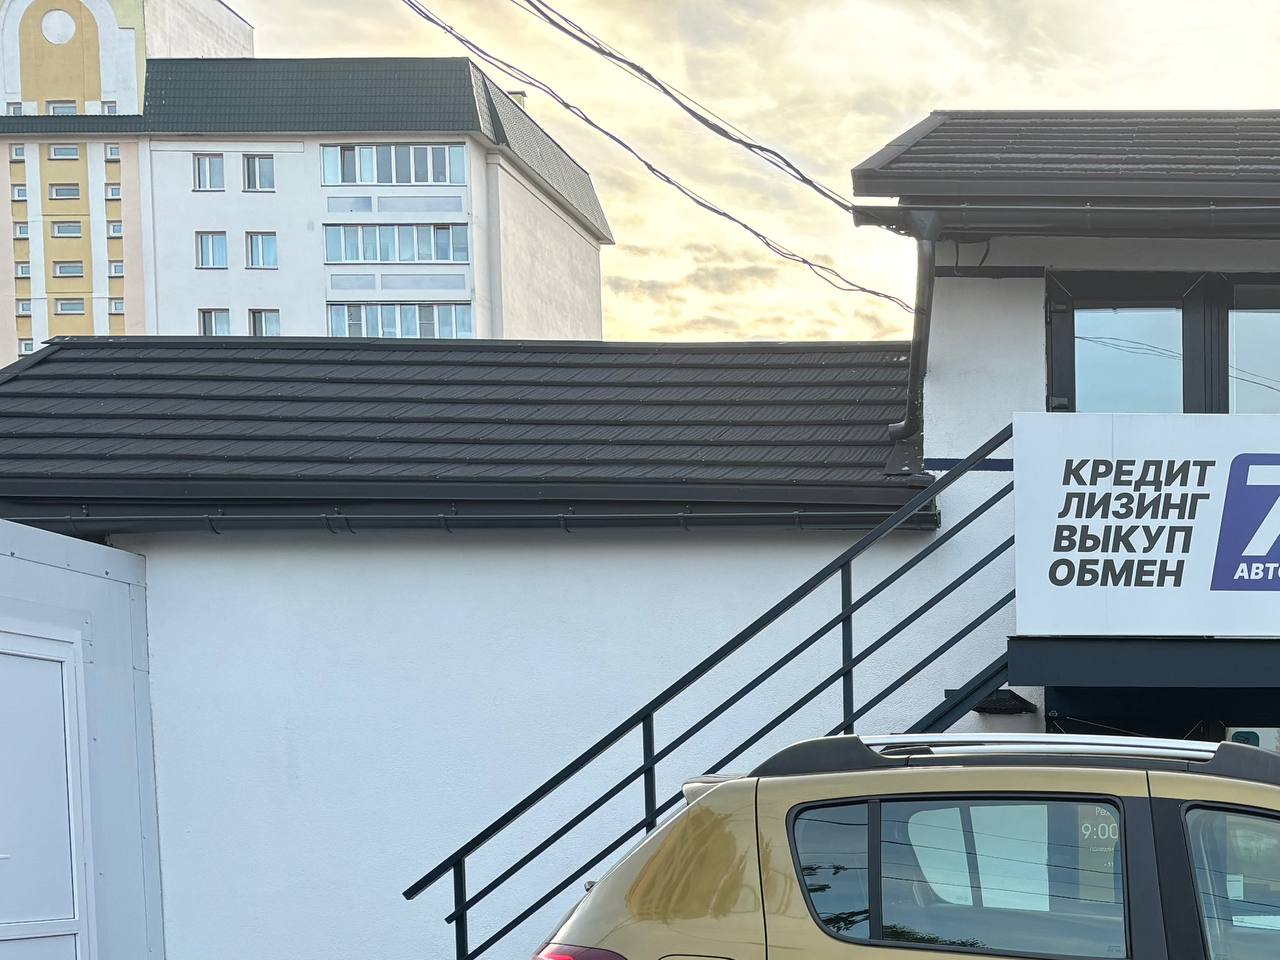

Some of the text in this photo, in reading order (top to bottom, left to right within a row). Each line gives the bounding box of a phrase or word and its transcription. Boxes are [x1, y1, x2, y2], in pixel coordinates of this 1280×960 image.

[1062, 458, 1217, 492] КРЕДИТ
[1057, 492, 1211, 520] ЛИЗИНГ
[1052, 524, 1194, 554] ВЫКУП
[1048, 558, 1185, 588] ОБМЕН
[1081, 823, 1119, 840] 9:00
